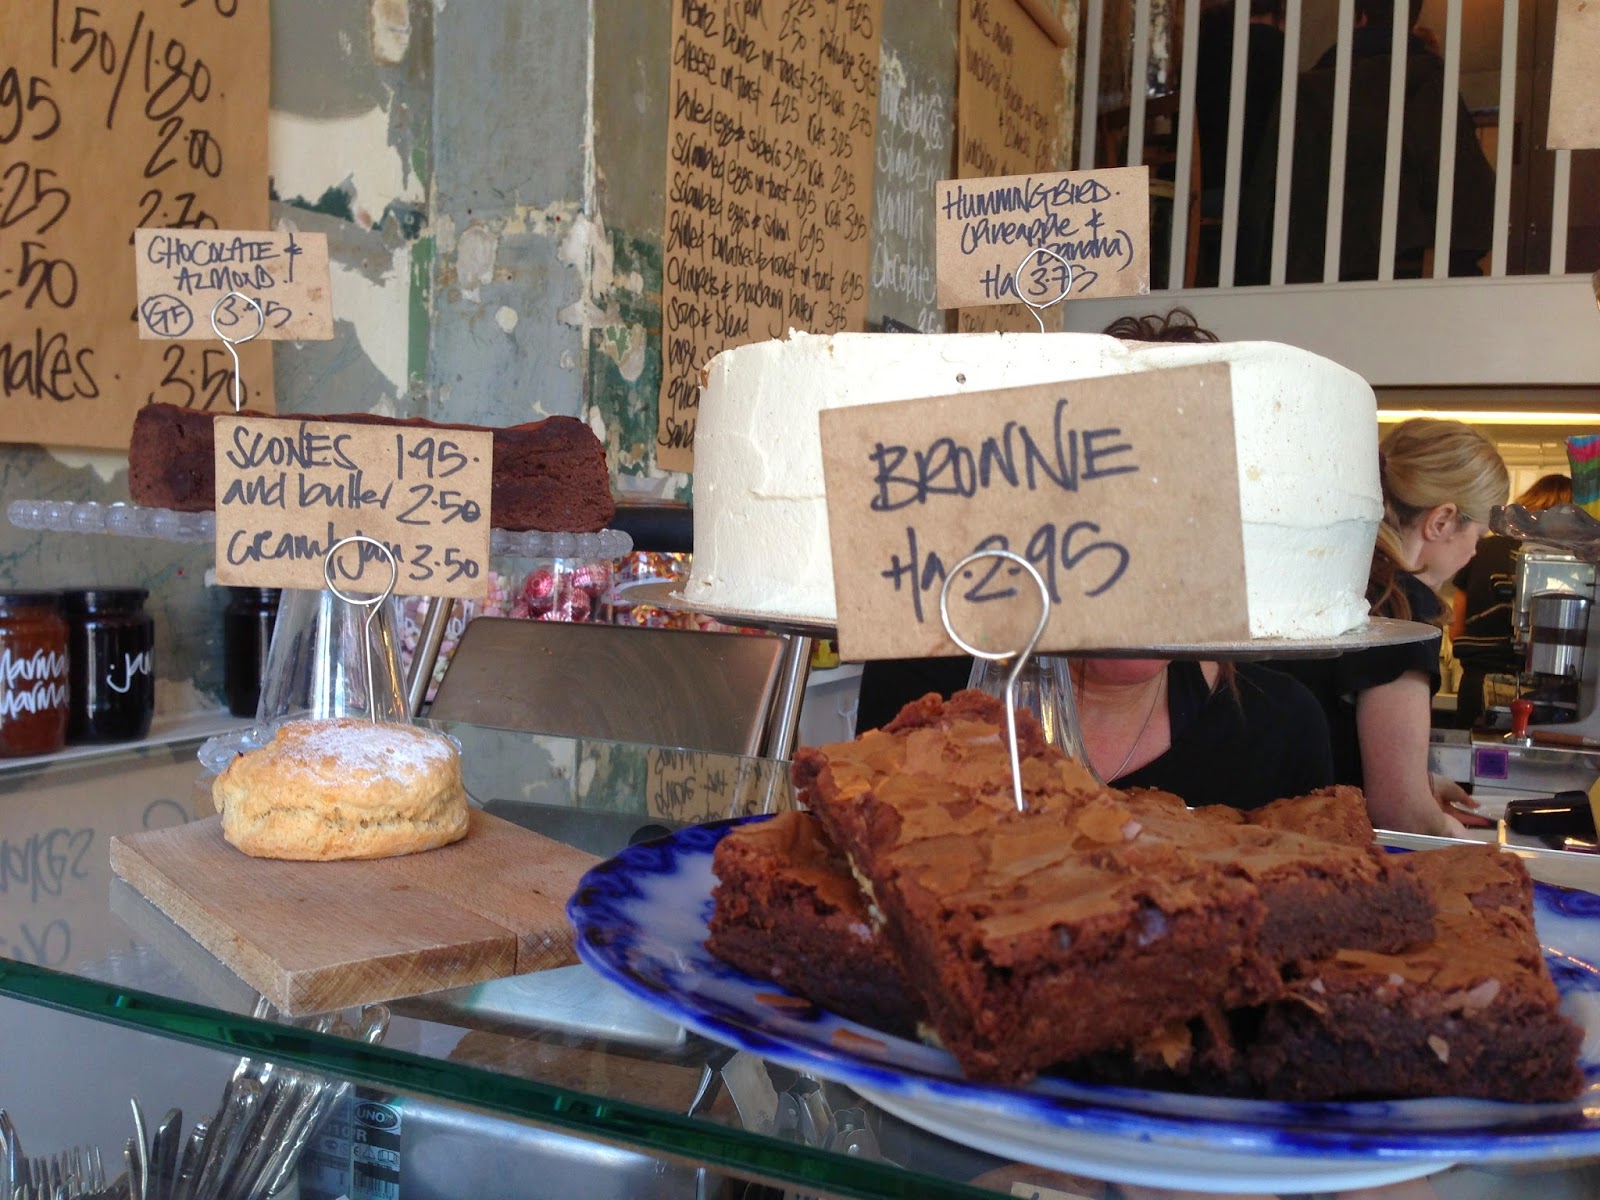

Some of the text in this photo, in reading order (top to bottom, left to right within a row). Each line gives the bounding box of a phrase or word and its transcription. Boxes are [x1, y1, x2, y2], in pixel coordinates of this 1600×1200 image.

[227, 421, 359, 470] SCONES
[869, 398, 1140, 513] BROWNIE
[222, 468, 482, 525] and butter 2.50
[408, 544, 480, 582] 3.50
